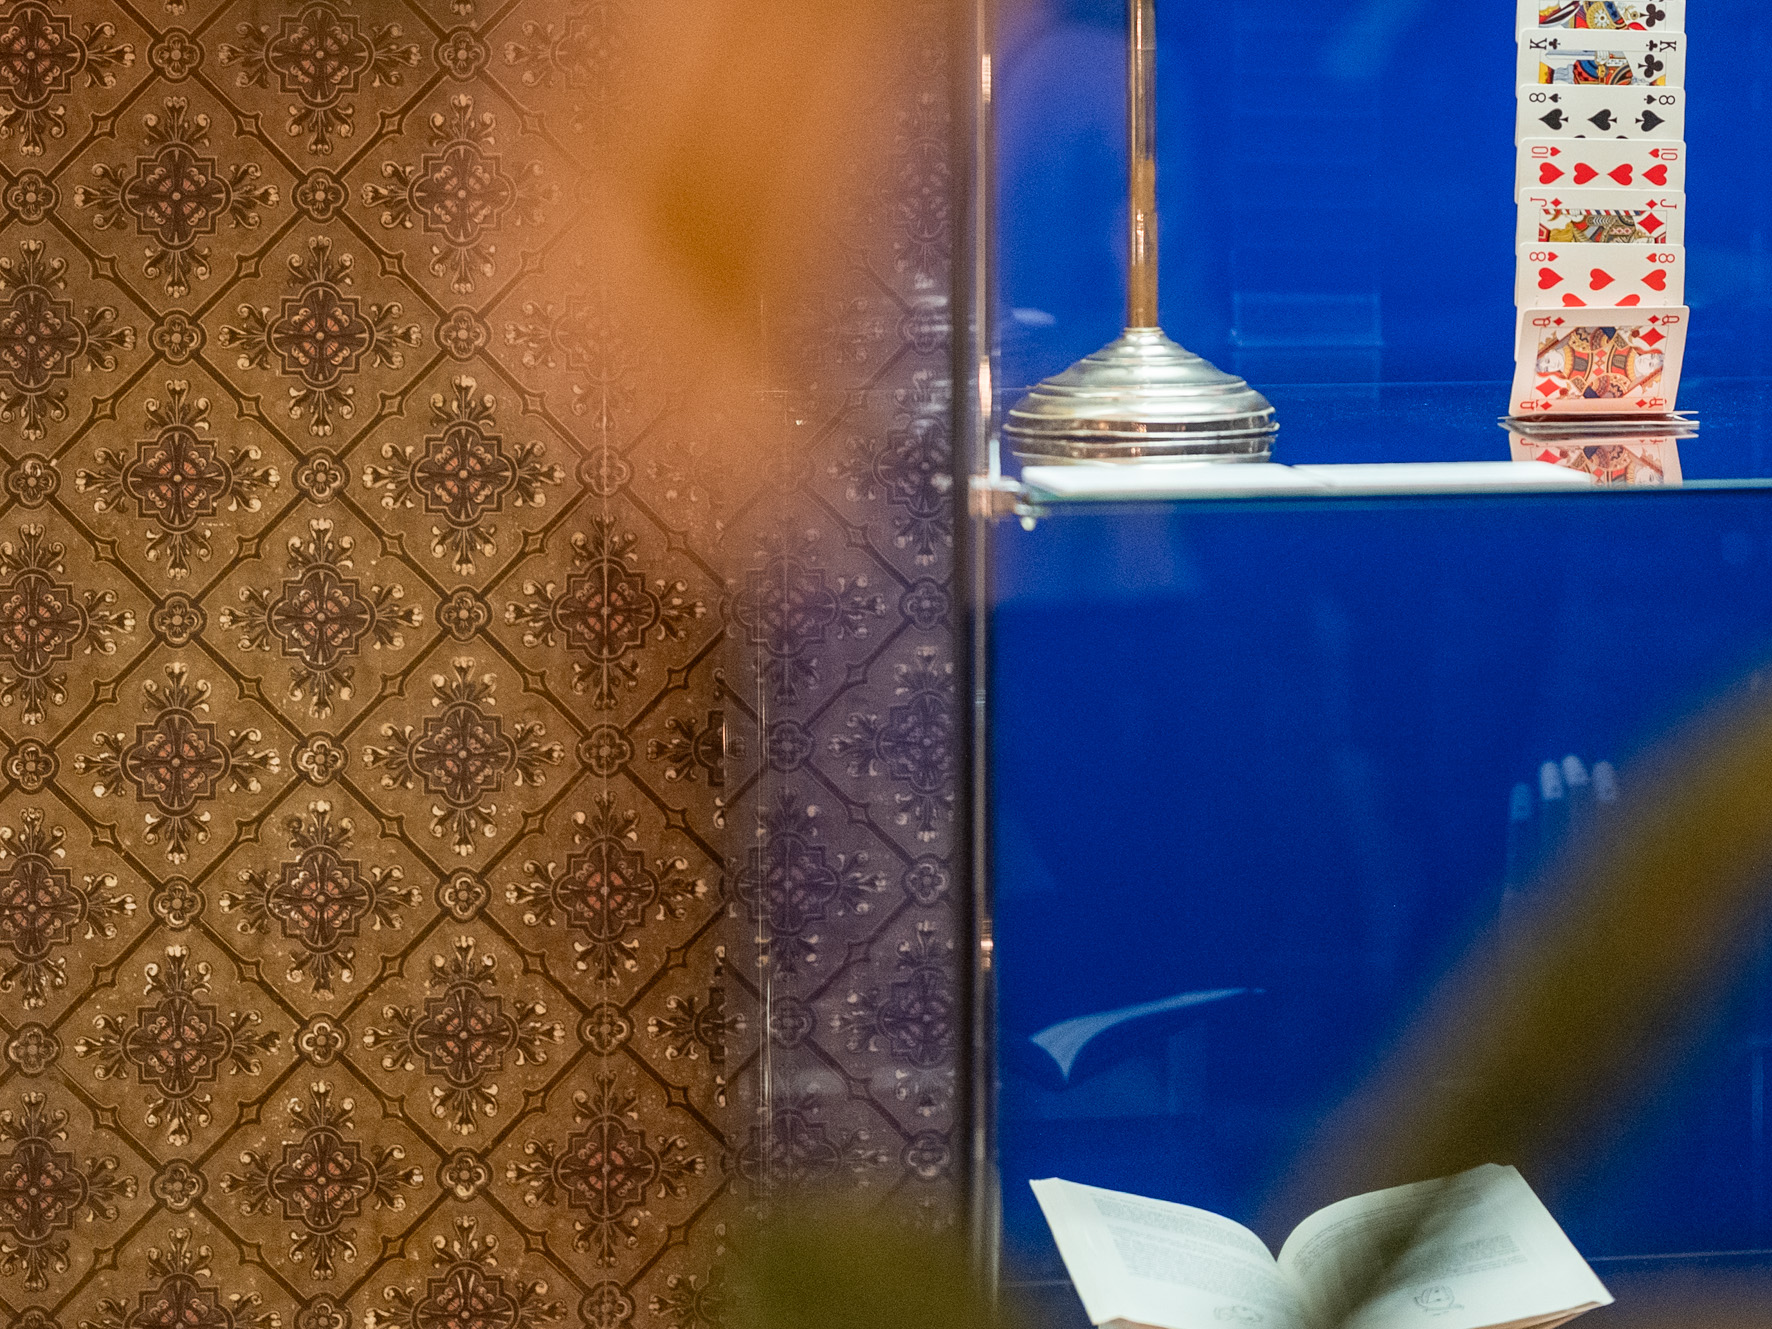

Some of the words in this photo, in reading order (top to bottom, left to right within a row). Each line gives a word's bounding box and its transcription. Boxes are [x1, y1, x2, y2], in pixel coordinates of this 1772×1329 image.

[1530, 38, 1547, 50] K
[1660, 41, 1676, 51] K
[1529, 93, 1546, 102] 8
[1659, 95, 1675, 105] 8
[1532, 146, 1548, 158] 10
[1661, 149, 1678, 160] 10
[1530, 197, 1547, 207] J
[1660, 199, 1676, 209] J
[1530, 252, 1546, 261] 8
[1659, 254, 1675, 263] 8
[1533, 317, 1551, 327] Q
[1662, 315, 1679, 325] Q
